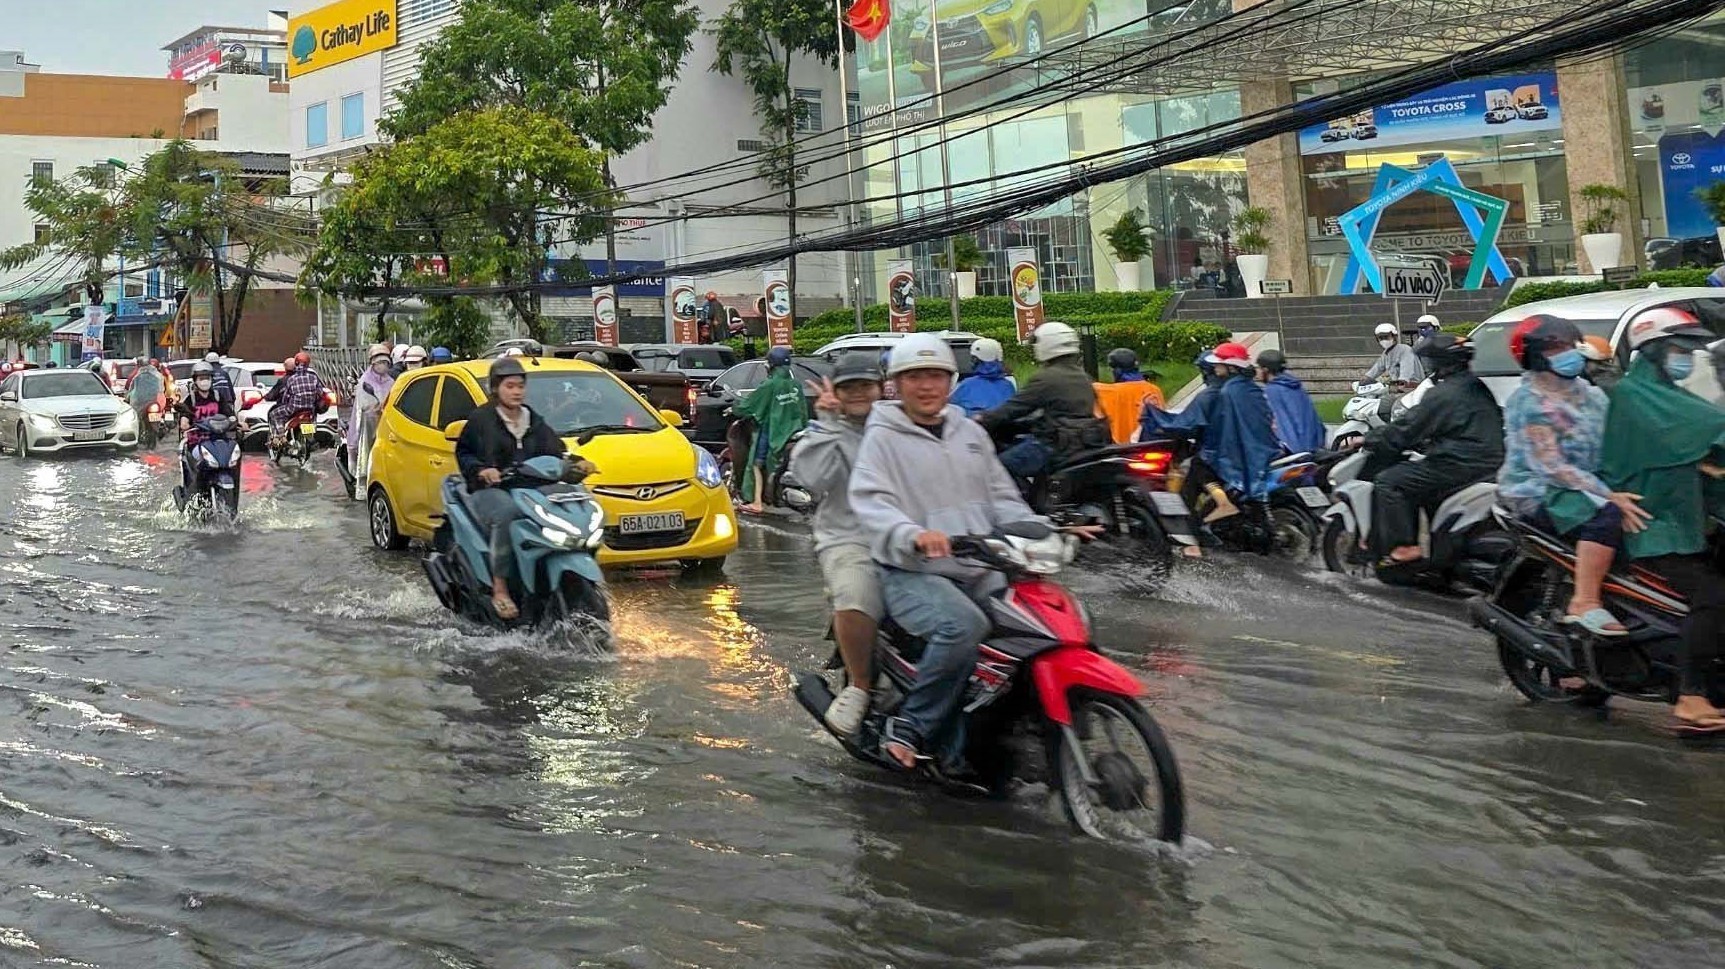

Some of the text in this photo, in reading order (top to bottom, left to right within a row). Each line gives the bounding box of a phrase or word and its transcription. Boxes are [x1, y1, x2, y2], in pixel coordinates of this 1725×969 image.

[321, 10, 390, 51] Cathay Life
[864, 103, 890, 116] WIGO
[1391, 101, 1466, 118] TOYOTA CROSS
[1365, 195, 1391, 214] TOYOTA
[1391, 182, 1411, 198] NINH
[1408, 237, 1423, 247] TO
[1425, 233, 1471, 246] TOYOTA
[1388, 269, 1433, 294] LỐI VÀO
